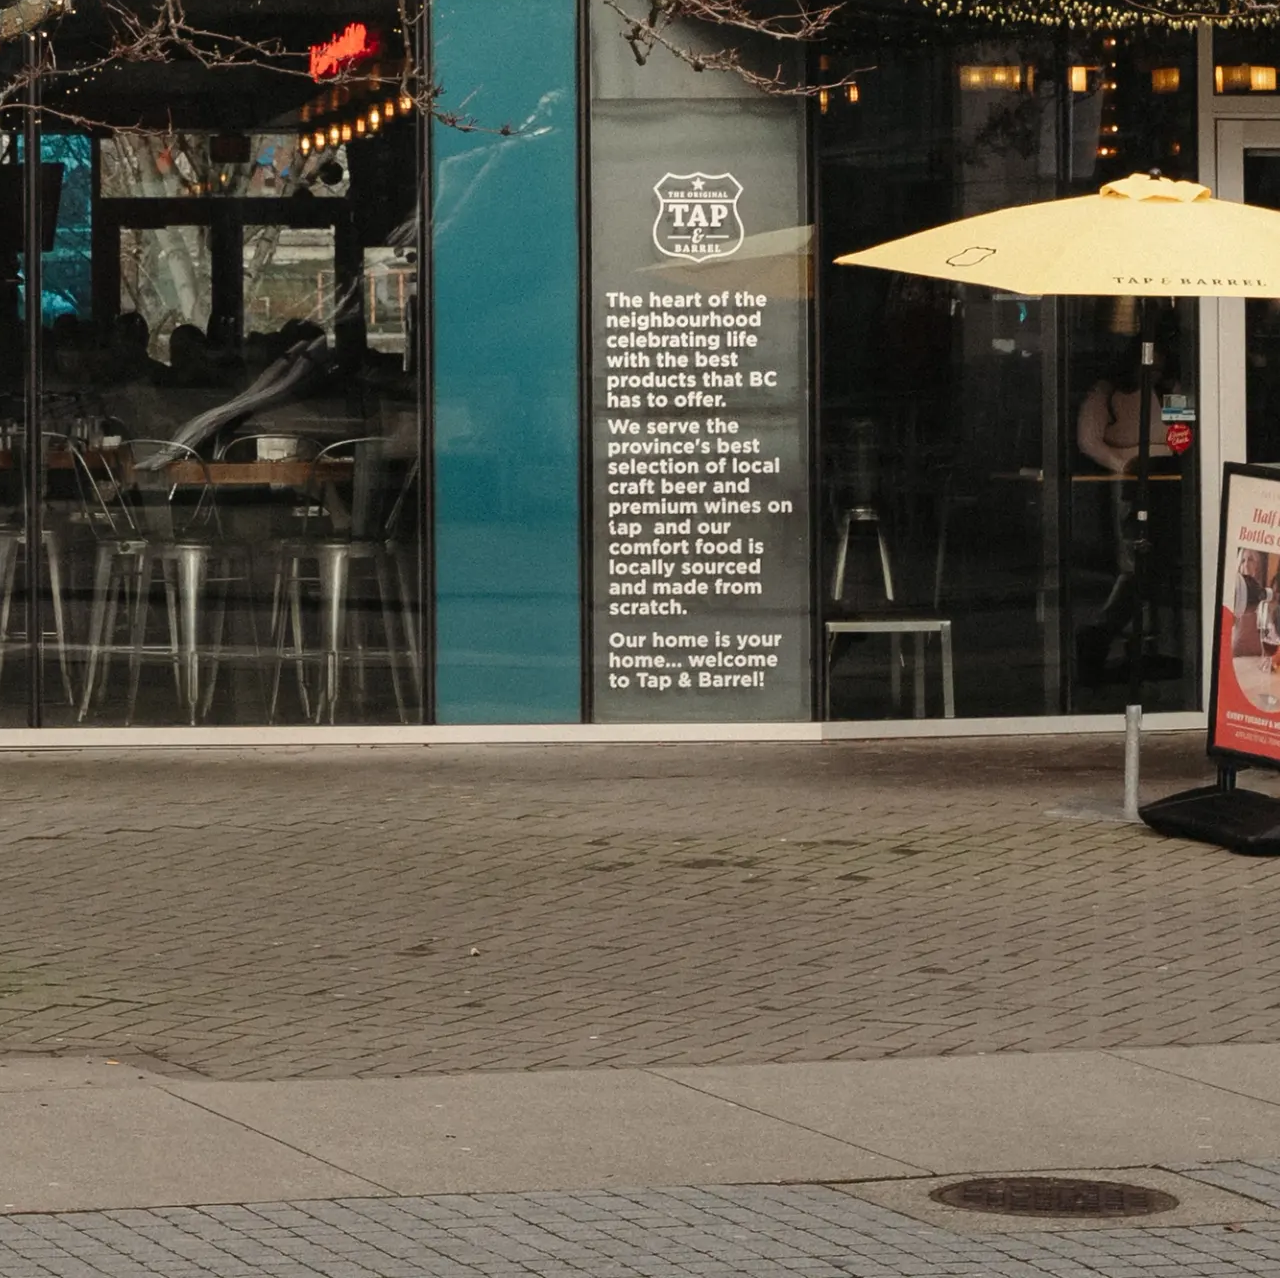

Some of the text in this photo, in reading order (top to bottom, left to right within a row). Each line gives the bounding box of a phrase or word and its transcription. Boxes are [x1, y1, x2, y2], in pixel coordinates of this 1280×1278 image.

[668, 191, 728, 199] THE ORIGINAL
[668, 204, 729, 228] TAP
[691, 227, 705, 244] &
[674, 243, 721, 254] BARREL
[1112, 276, 1153, 285] TAP
[1180, 277, 1268, 287] BARREL
[604, 290, 768, 308] The heart of the
[605, 311, 762, 330] neighbourhood
[605, 330, 759, 350] celebrating life
[605, 351, 739, 368] with the best
[606, 371, 778, 390] products that BC
[606, 391, 727, 408] has to offer.
[607, 418, 740, 434] We serve the
[607, 438, 761, 457] province's best
[607, 457, 780, 475] selection of local
[607, 478, 750, 494] craft beer and
[608, 498, 793, 517] premium wines on
[1252, 508, 1278, 528] Half
[608, 519, 732, 537] tap and our
[1238, 526, 1276, 546] Bottles
[608, 537, 764, 555] comfort food is
[609, 558, 761, 577] locally sourced
[608, 579, 763, 595] and made from
[609, 599, 688, 615] scratch.
[608, 631, 783, 650] Our home is your
[608, 652, 779, 668] home... welcome
[608, 671, 765, 690] to Tap & Barrel!
